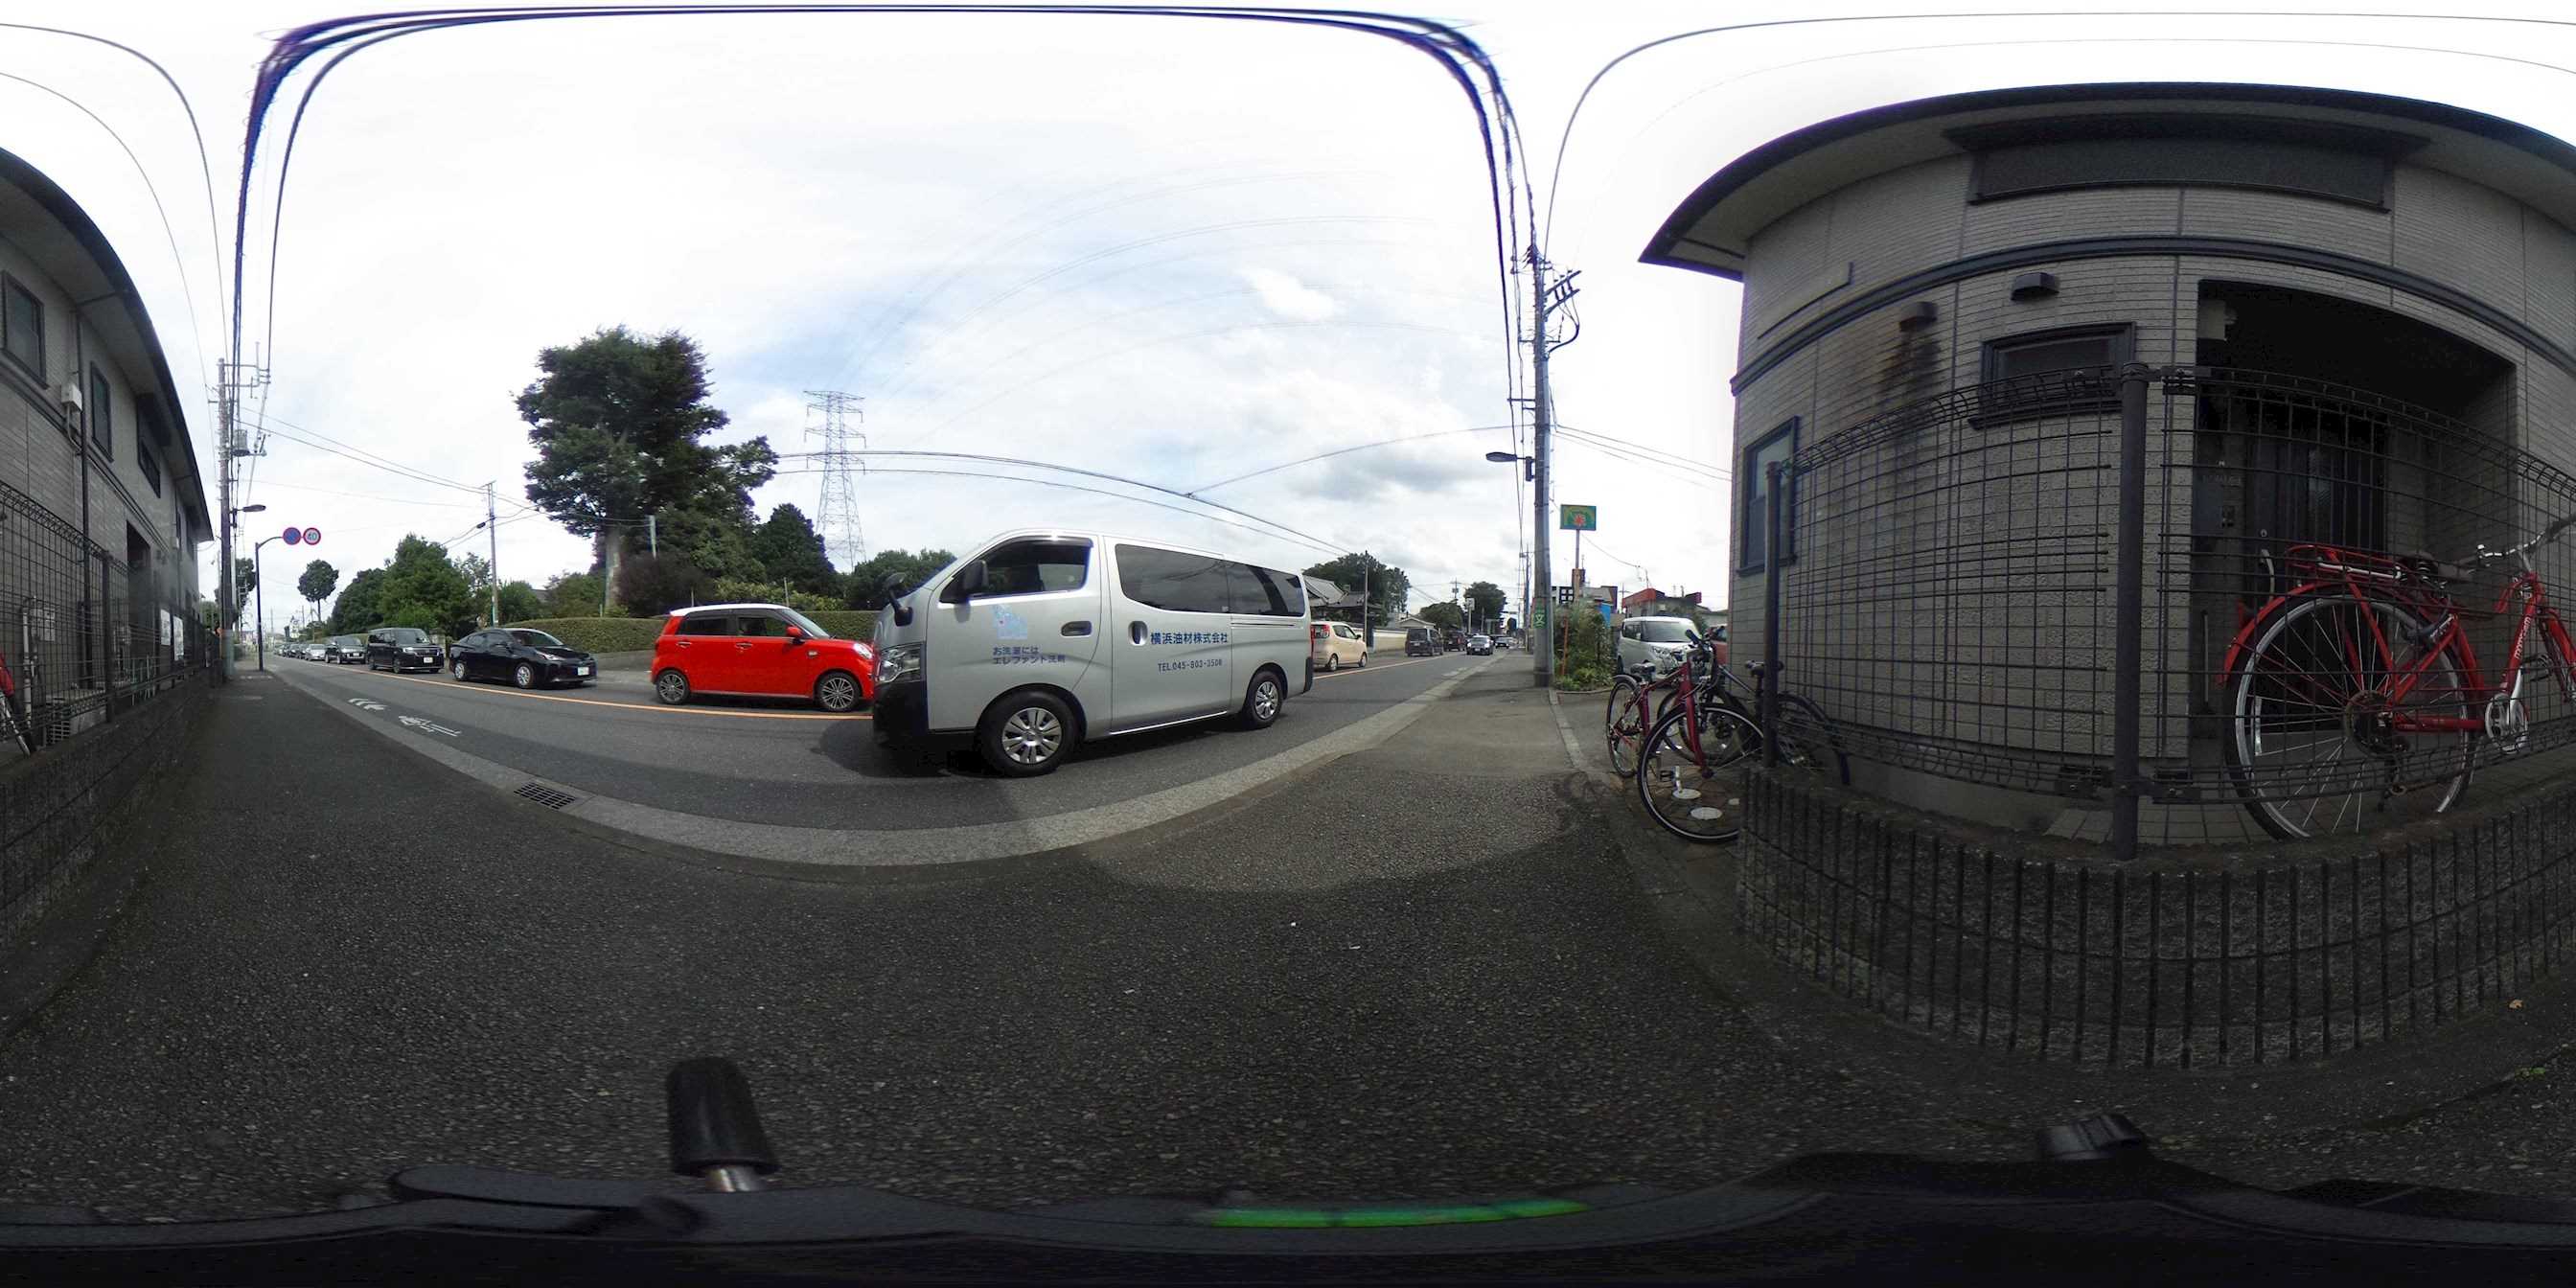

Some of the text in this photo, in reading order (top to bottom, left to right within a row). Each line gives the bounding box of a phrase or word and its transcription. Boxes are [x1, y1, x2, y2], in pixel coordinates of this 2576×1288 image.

[1150, 632, 1228, 645] 横浜油材株式会社
